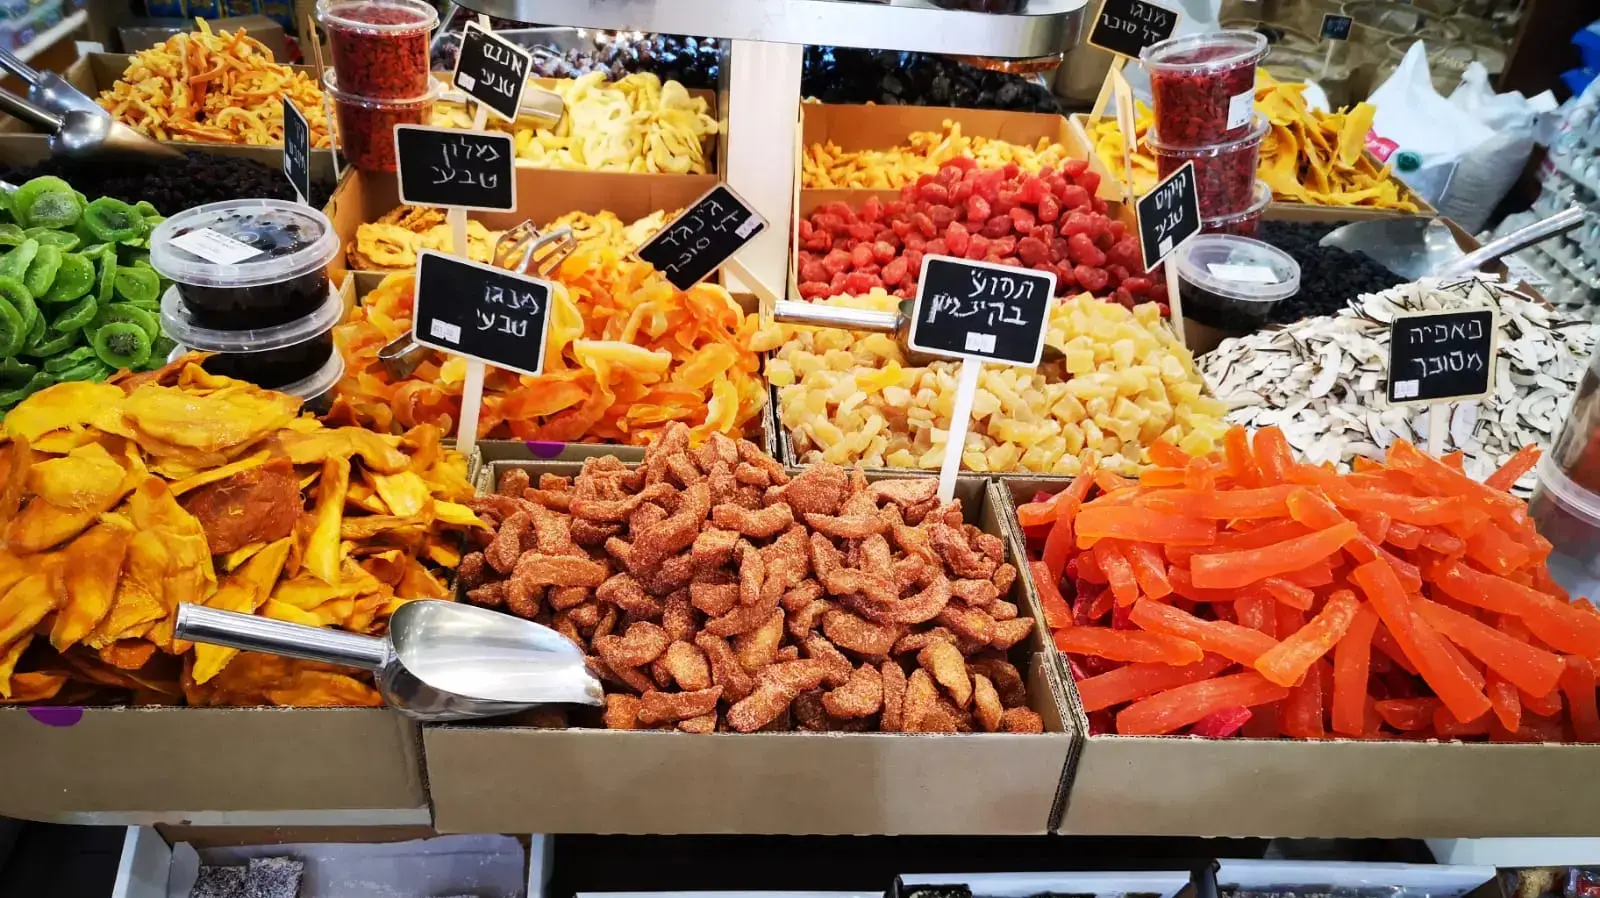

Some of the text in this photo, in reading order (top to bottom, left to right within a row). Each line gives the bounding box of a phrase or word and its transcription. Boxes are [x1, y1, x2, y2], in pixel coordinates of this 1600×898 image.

[431, 166, 498, 189] טבעי
[1154, 205, 1183, 242] טבעי
[665, 237, 711, 272] סוכר
[484, 285, 539, 315] מנגו
[476, 308, 528, 336] טבעי
[1409, 319, 1483, 344] פאפיה
[1411, 350, 1484, 378] מסוכר
